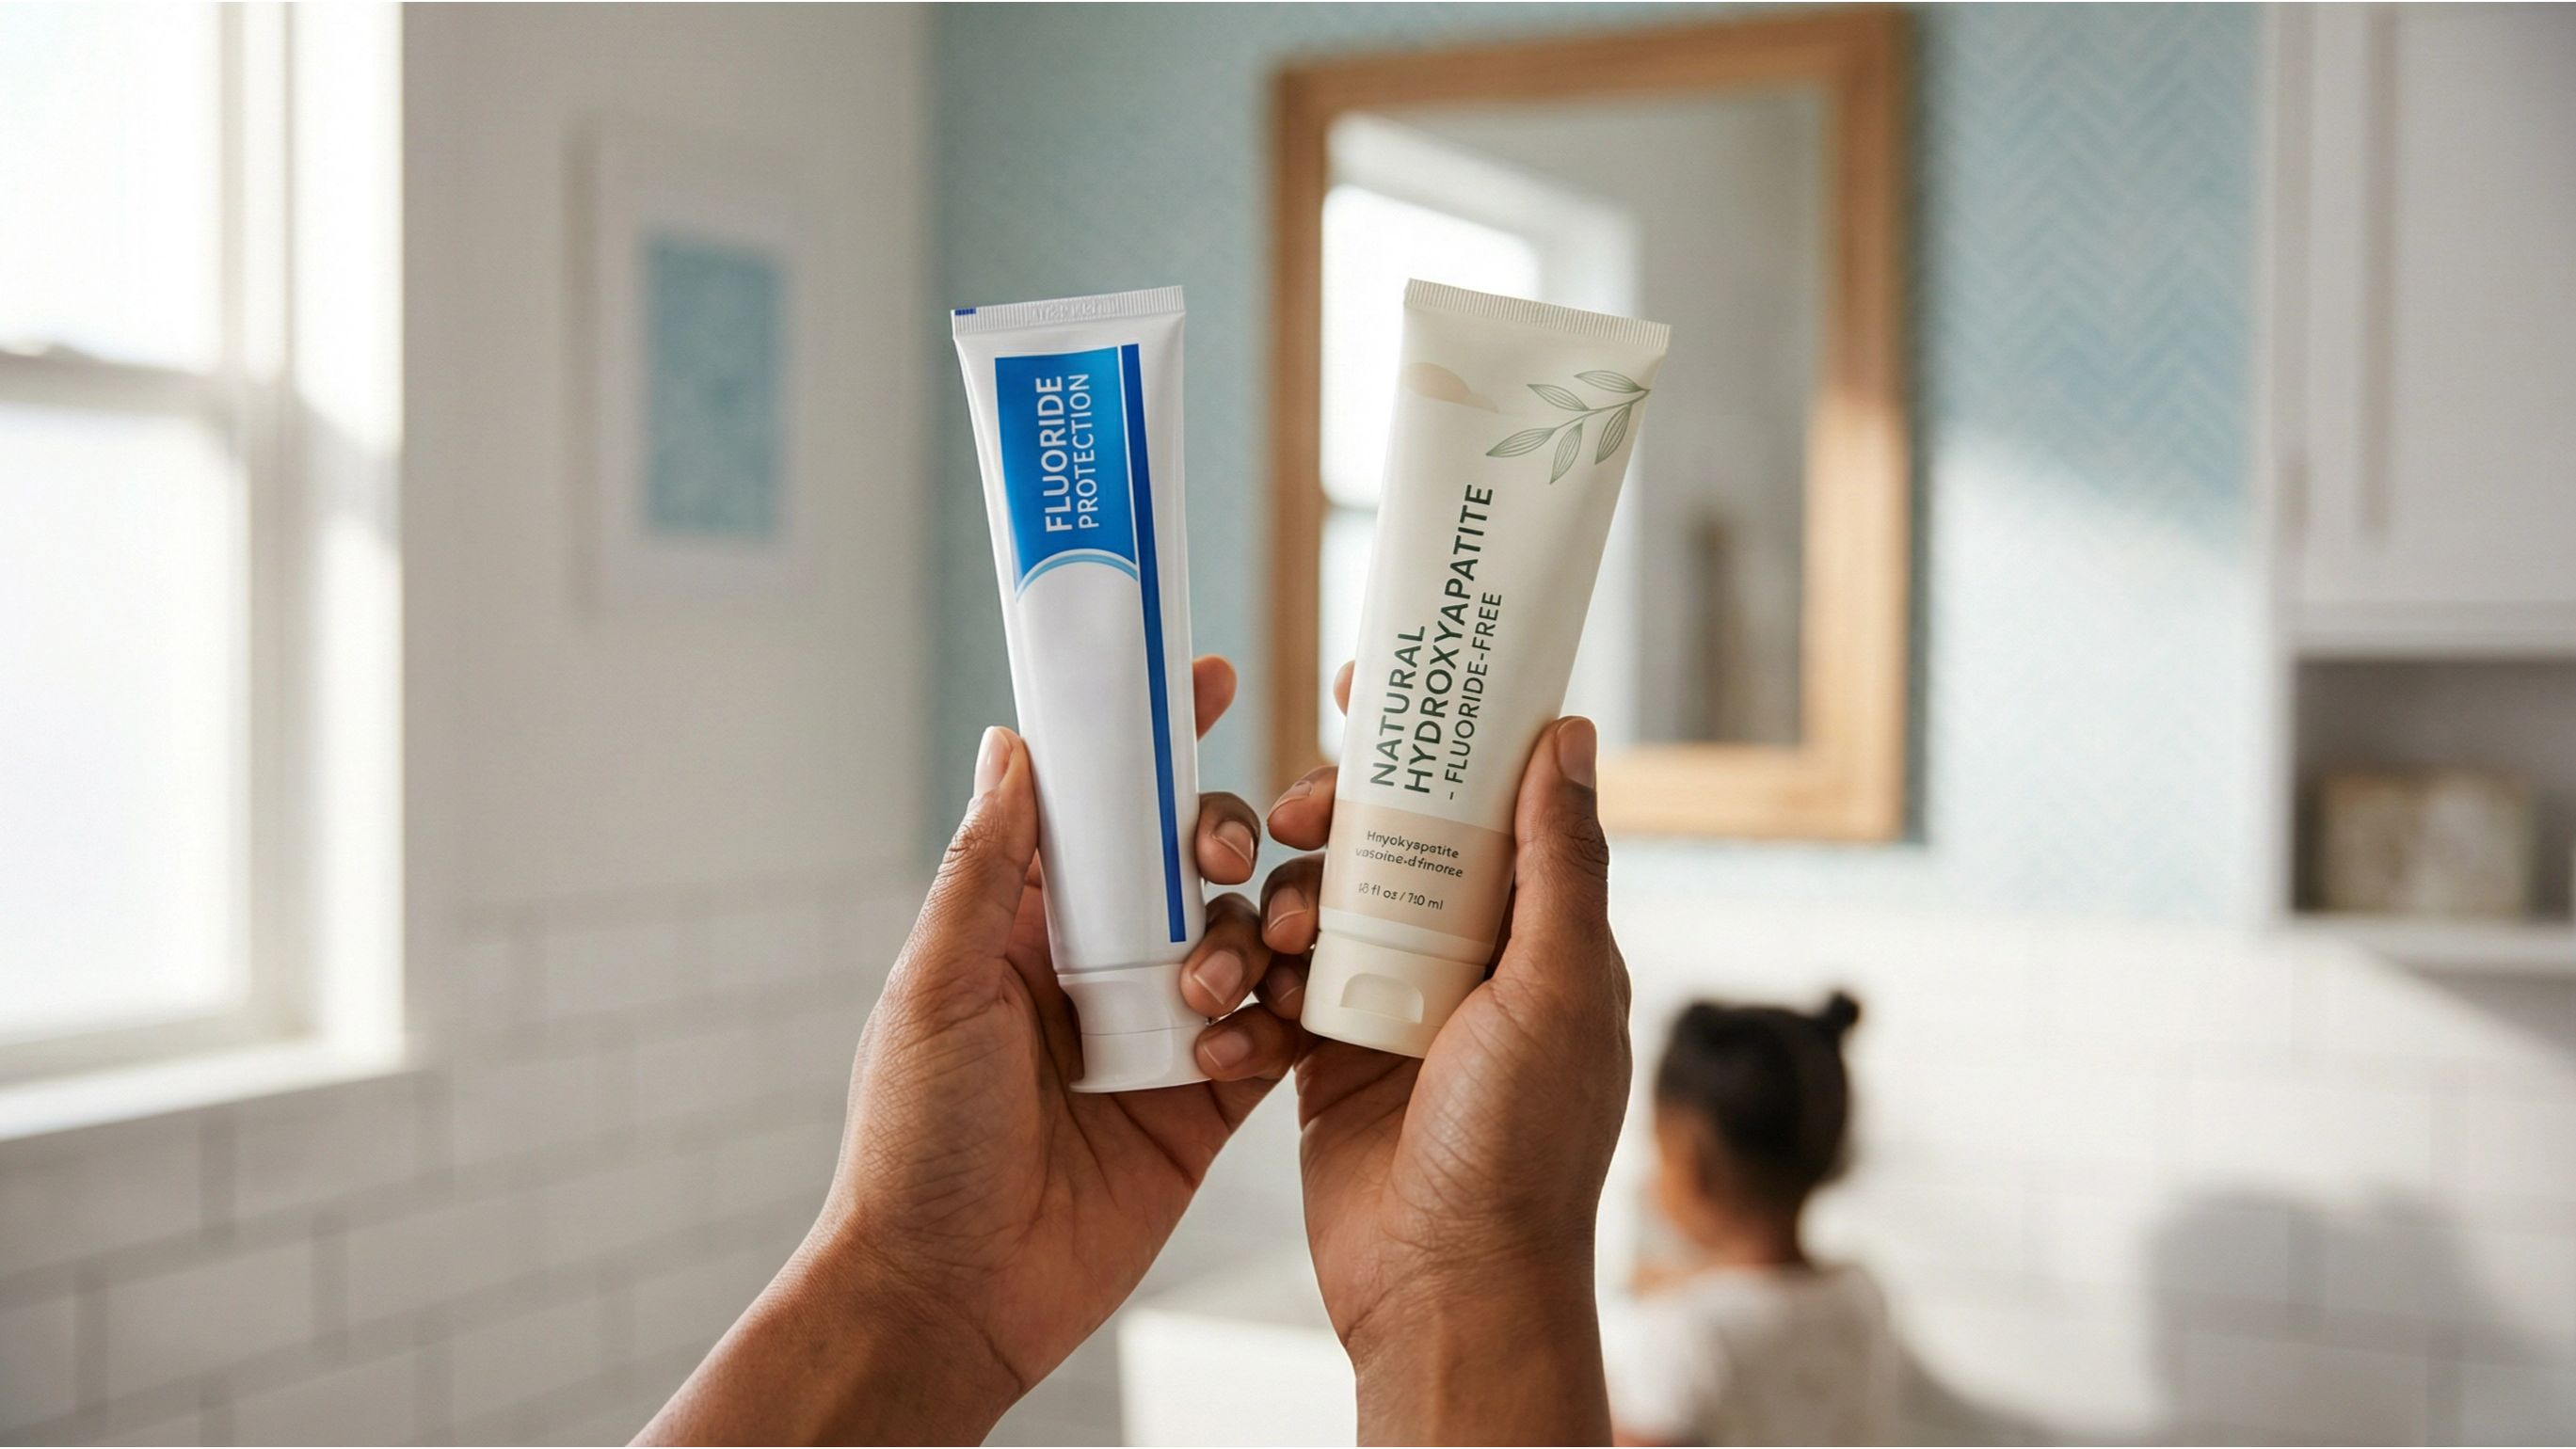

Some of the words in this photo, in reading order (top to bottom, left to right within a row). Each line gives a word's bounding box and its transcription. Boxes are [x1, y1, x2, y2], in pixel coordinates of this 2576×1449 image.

[1035, 375, 1073, 533] FLUORIDE
[1068, 374, 1099, 529] PROTECTION
[1370, 625, 1426, 788] NATURAL
[1404, 484, 1494, 794] HYDROXYAPATITE
[1444, 592, 1502, 784] FLUORIDE-FREE
